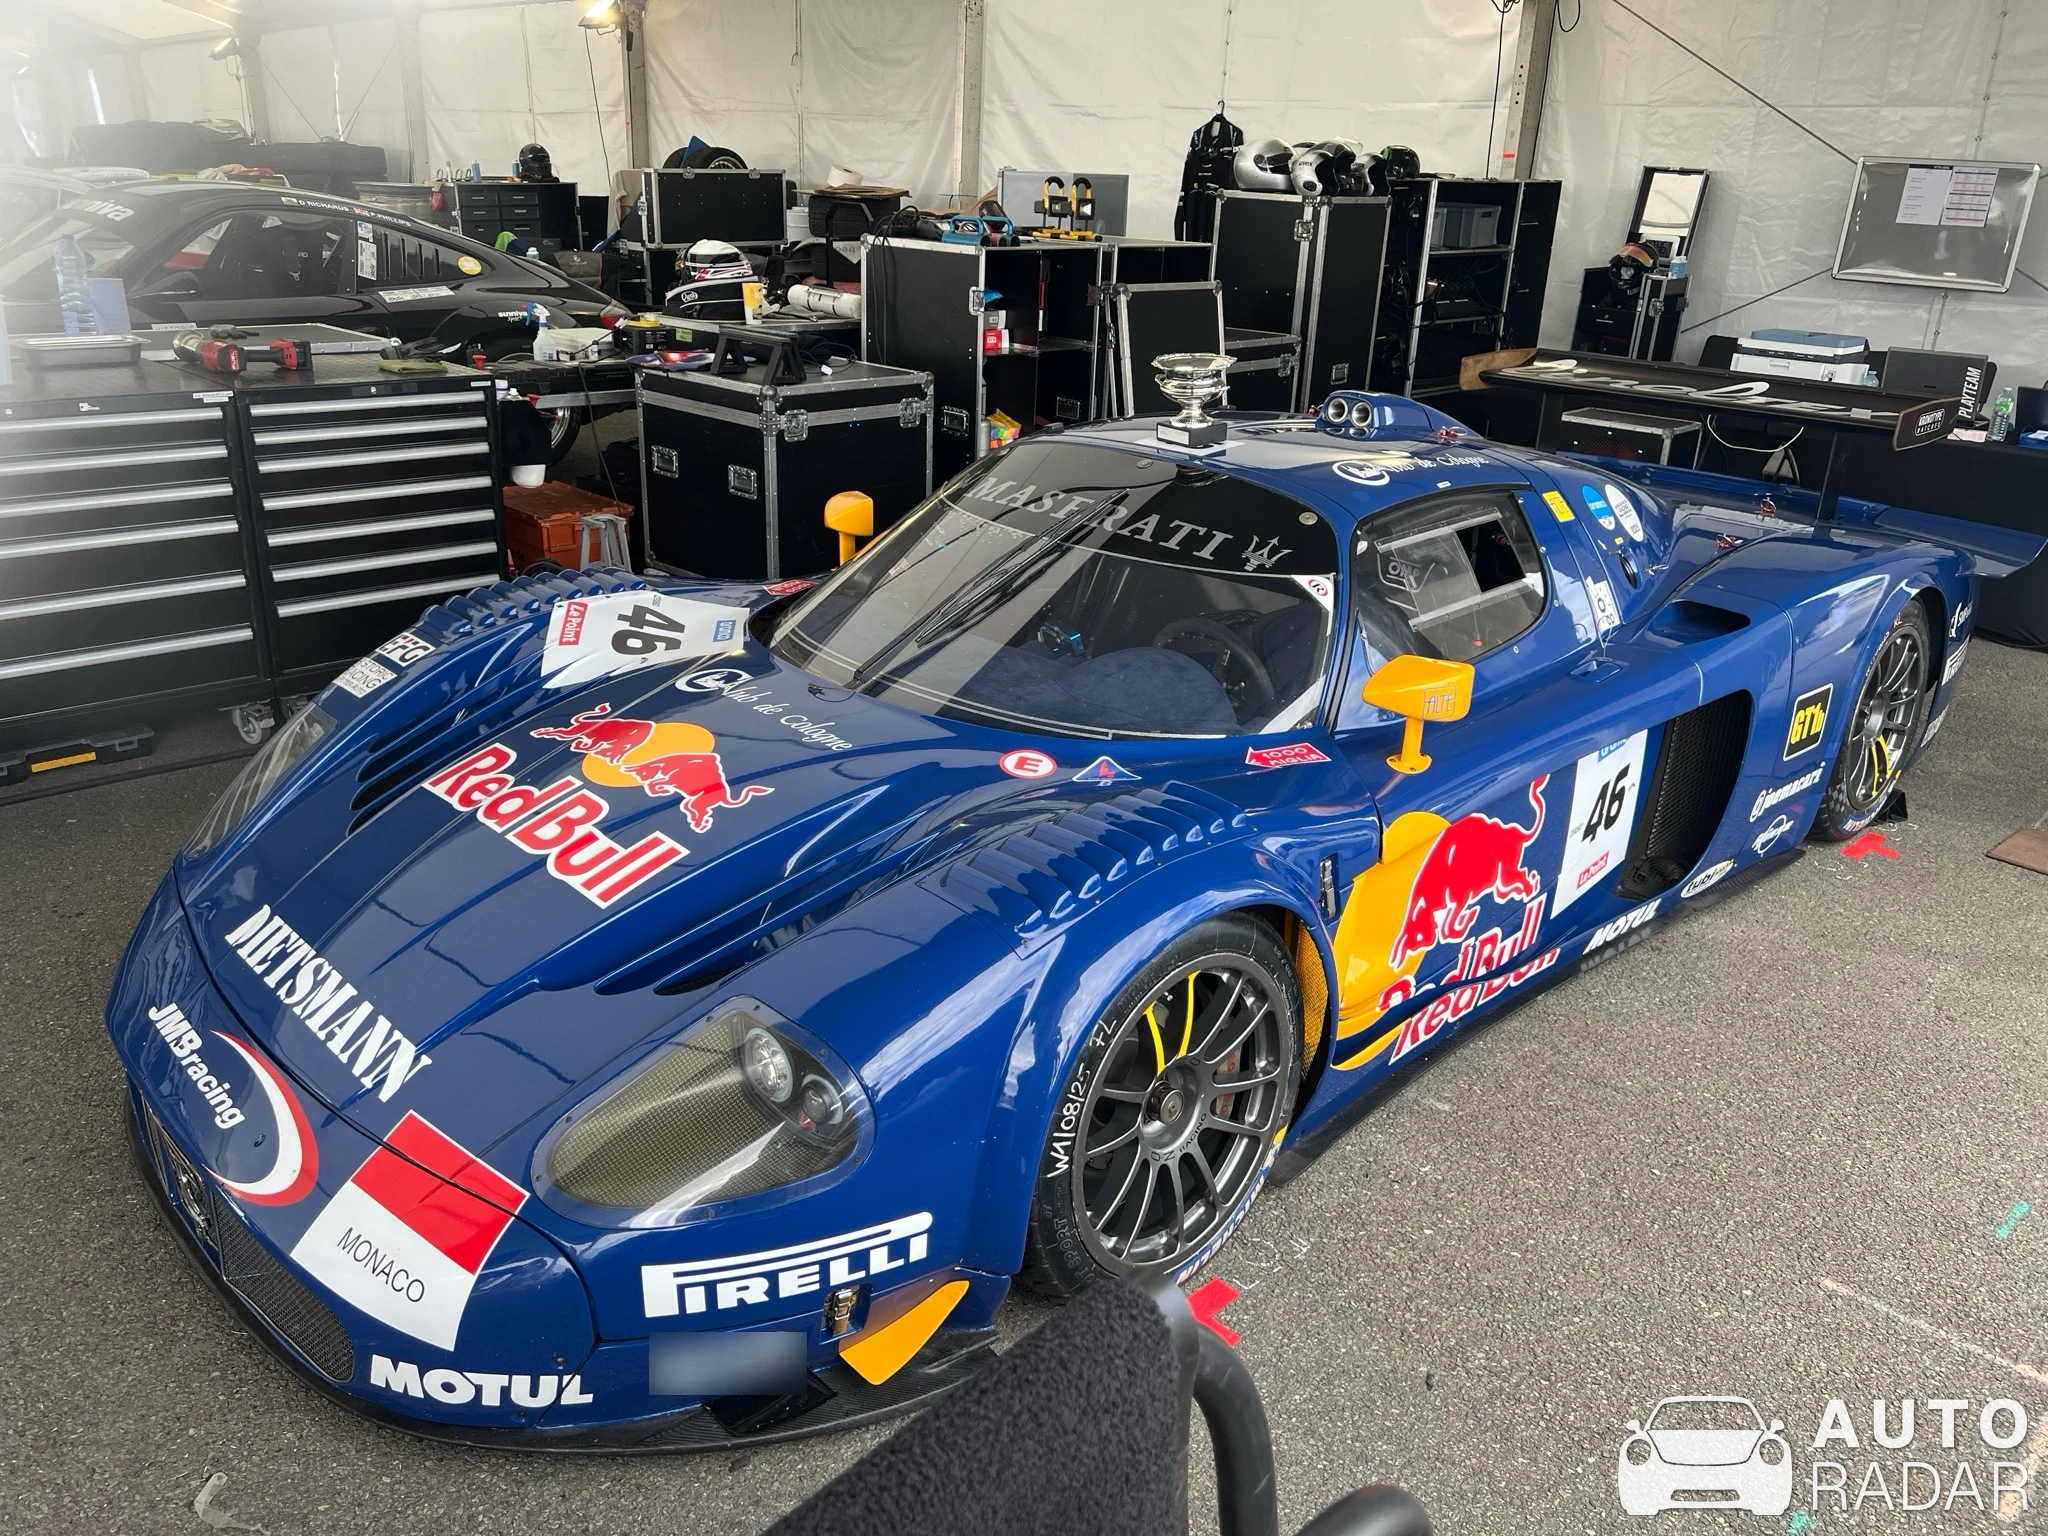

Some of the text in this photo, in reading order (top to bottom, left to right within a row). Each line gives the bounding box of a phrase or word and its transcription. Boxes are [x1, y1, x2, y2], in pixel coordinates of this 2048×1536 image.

[1958, 366, 1982, 419] PLAYTEAM
[963, 475, 1234, 562] MASERATI
[1388, 561, 1420, 578] OMP
[563, 616, 580, 642] Point
[611, 604, 686, 656] 46
[1262, 746, 1308, 760] 1000
[1268, 754, 1323, 767] MIGLIA
[1581, 762, 1632, 843] 46
[1588, 857, 1608, 880] Point
[1582, 898, 1662, 955] MOTUL
[224, 903, 433, 1103] DIETSMANN
[1179, 1112, 1208, 1153] RACING
[1053, 1217, 1083, 1271] SPORT
[1175, 1173, 1266, 1286] MICHELIN
[336, 1226, 427, 1305] MONACO
[641, 1211, 932, 1319] PIRELLI
[370, 1354, 594, 1408] MOTUL
